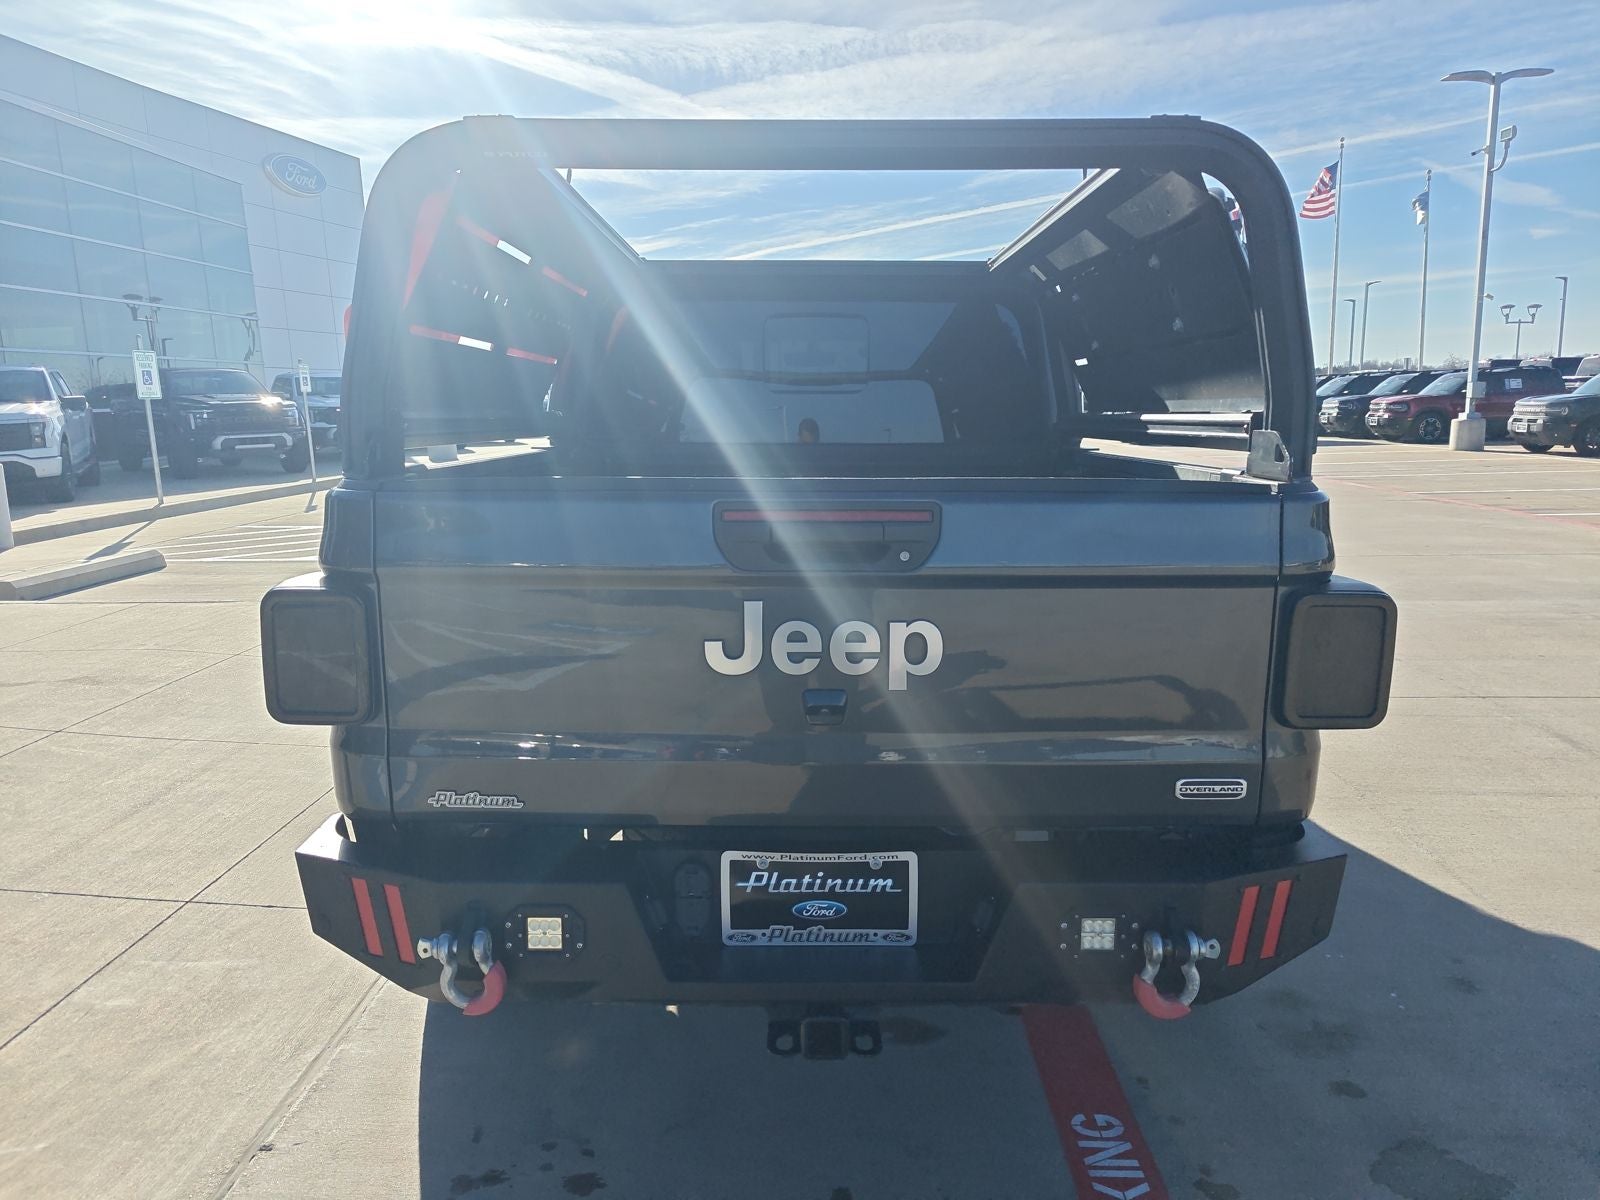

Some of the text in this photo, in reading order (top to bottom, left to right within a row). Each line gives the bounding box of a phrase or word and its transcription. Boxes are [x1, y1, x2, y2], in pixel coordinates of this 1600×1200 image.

[286, 162, 317, 189] Ford
[704, 601, 943, 690] Jeep
[427, 791, 524, 808] Platinum
[741, 852, 898, 861] www.PlatinumFord.com
[736, 872, 902, 892] Platinum
[803, 904, 836, 916] Ford
[767, 926, 877, 943] Platinum
